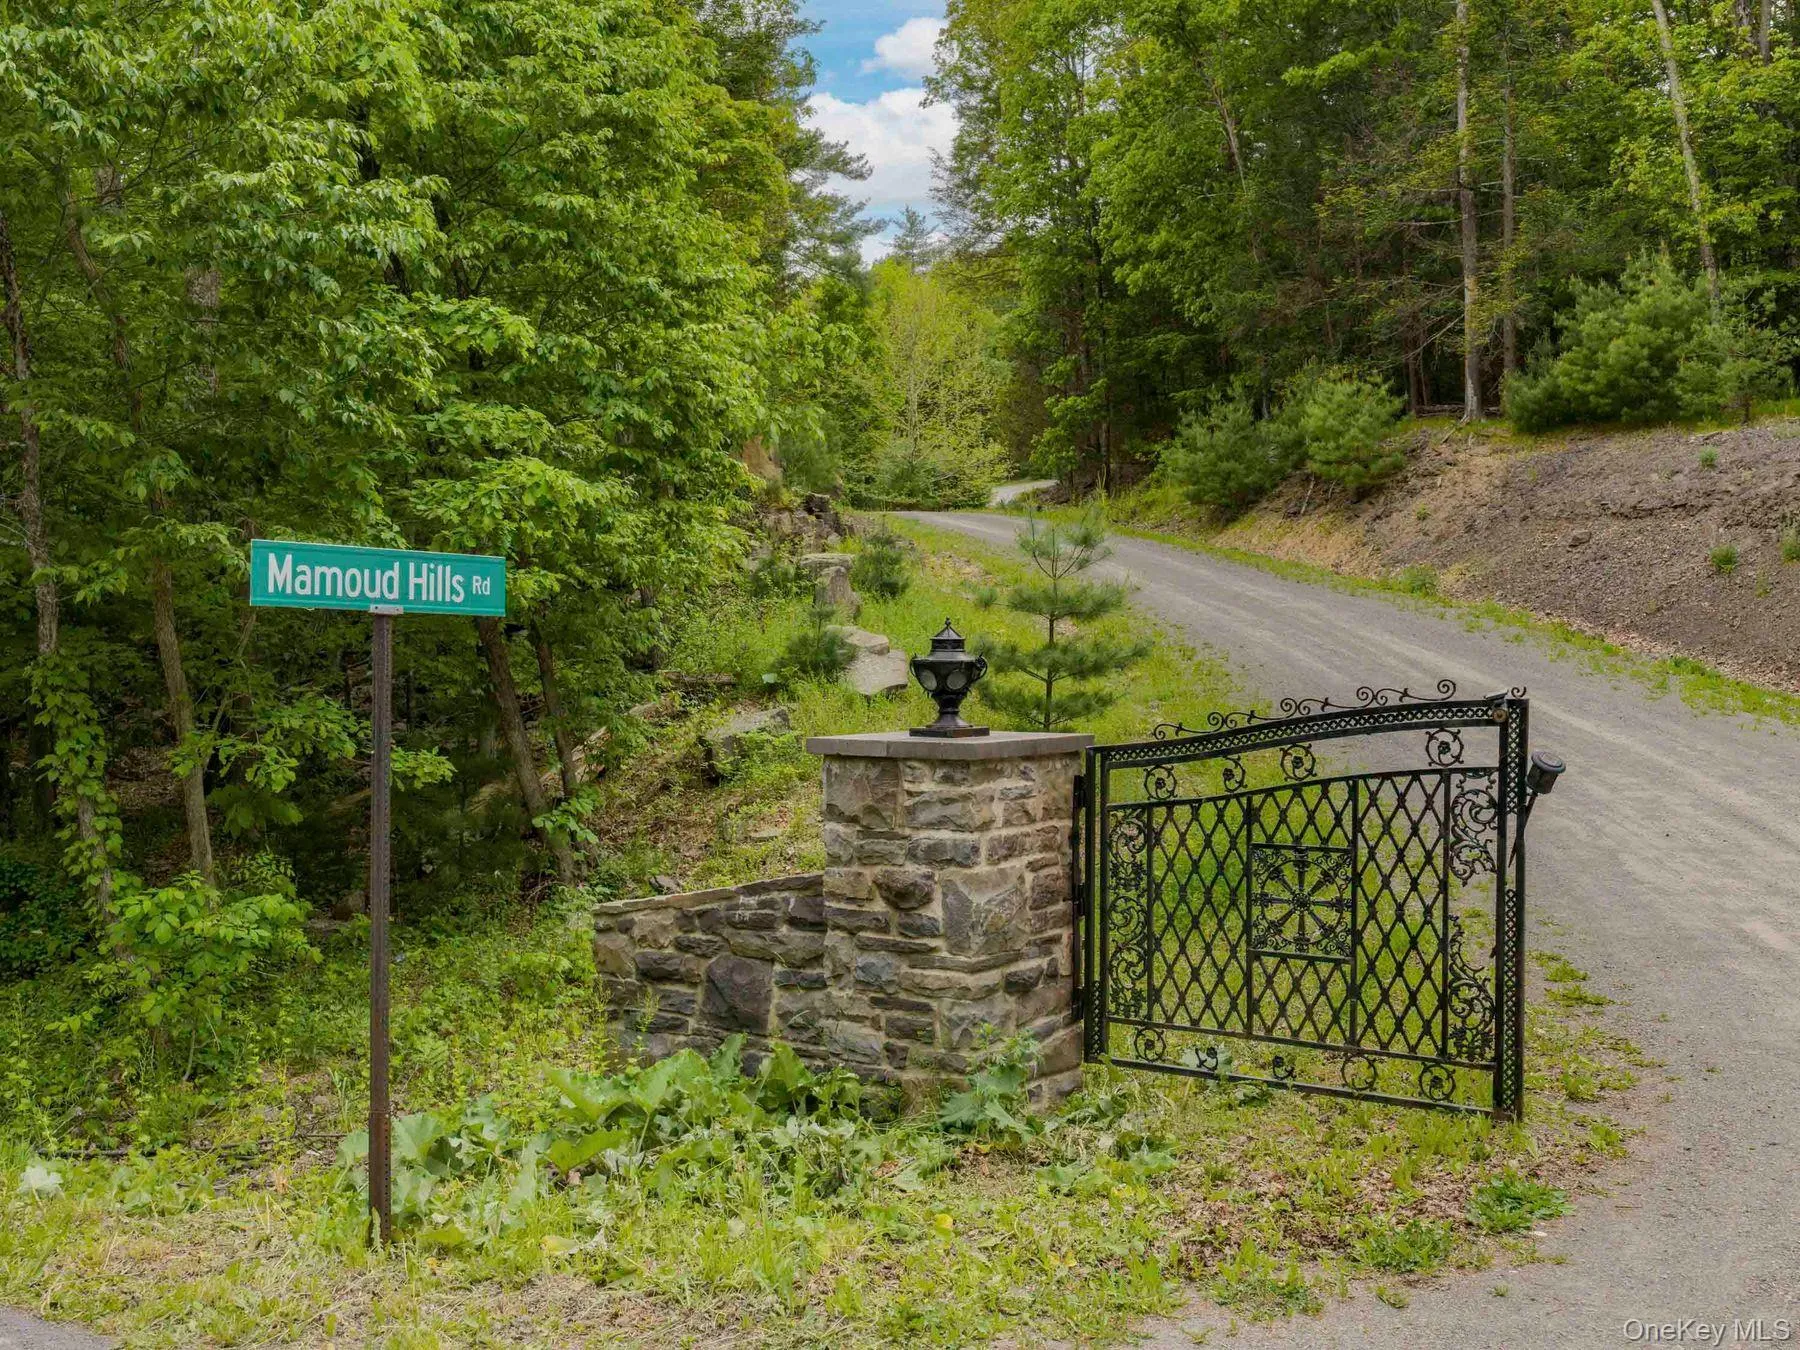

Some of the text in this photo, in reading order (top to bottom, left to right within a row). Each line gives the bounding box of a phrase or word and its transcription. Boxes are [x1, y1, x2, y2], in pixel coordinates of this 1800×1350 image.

[268, 553, 490, 603] Mamoud Hills Rd
